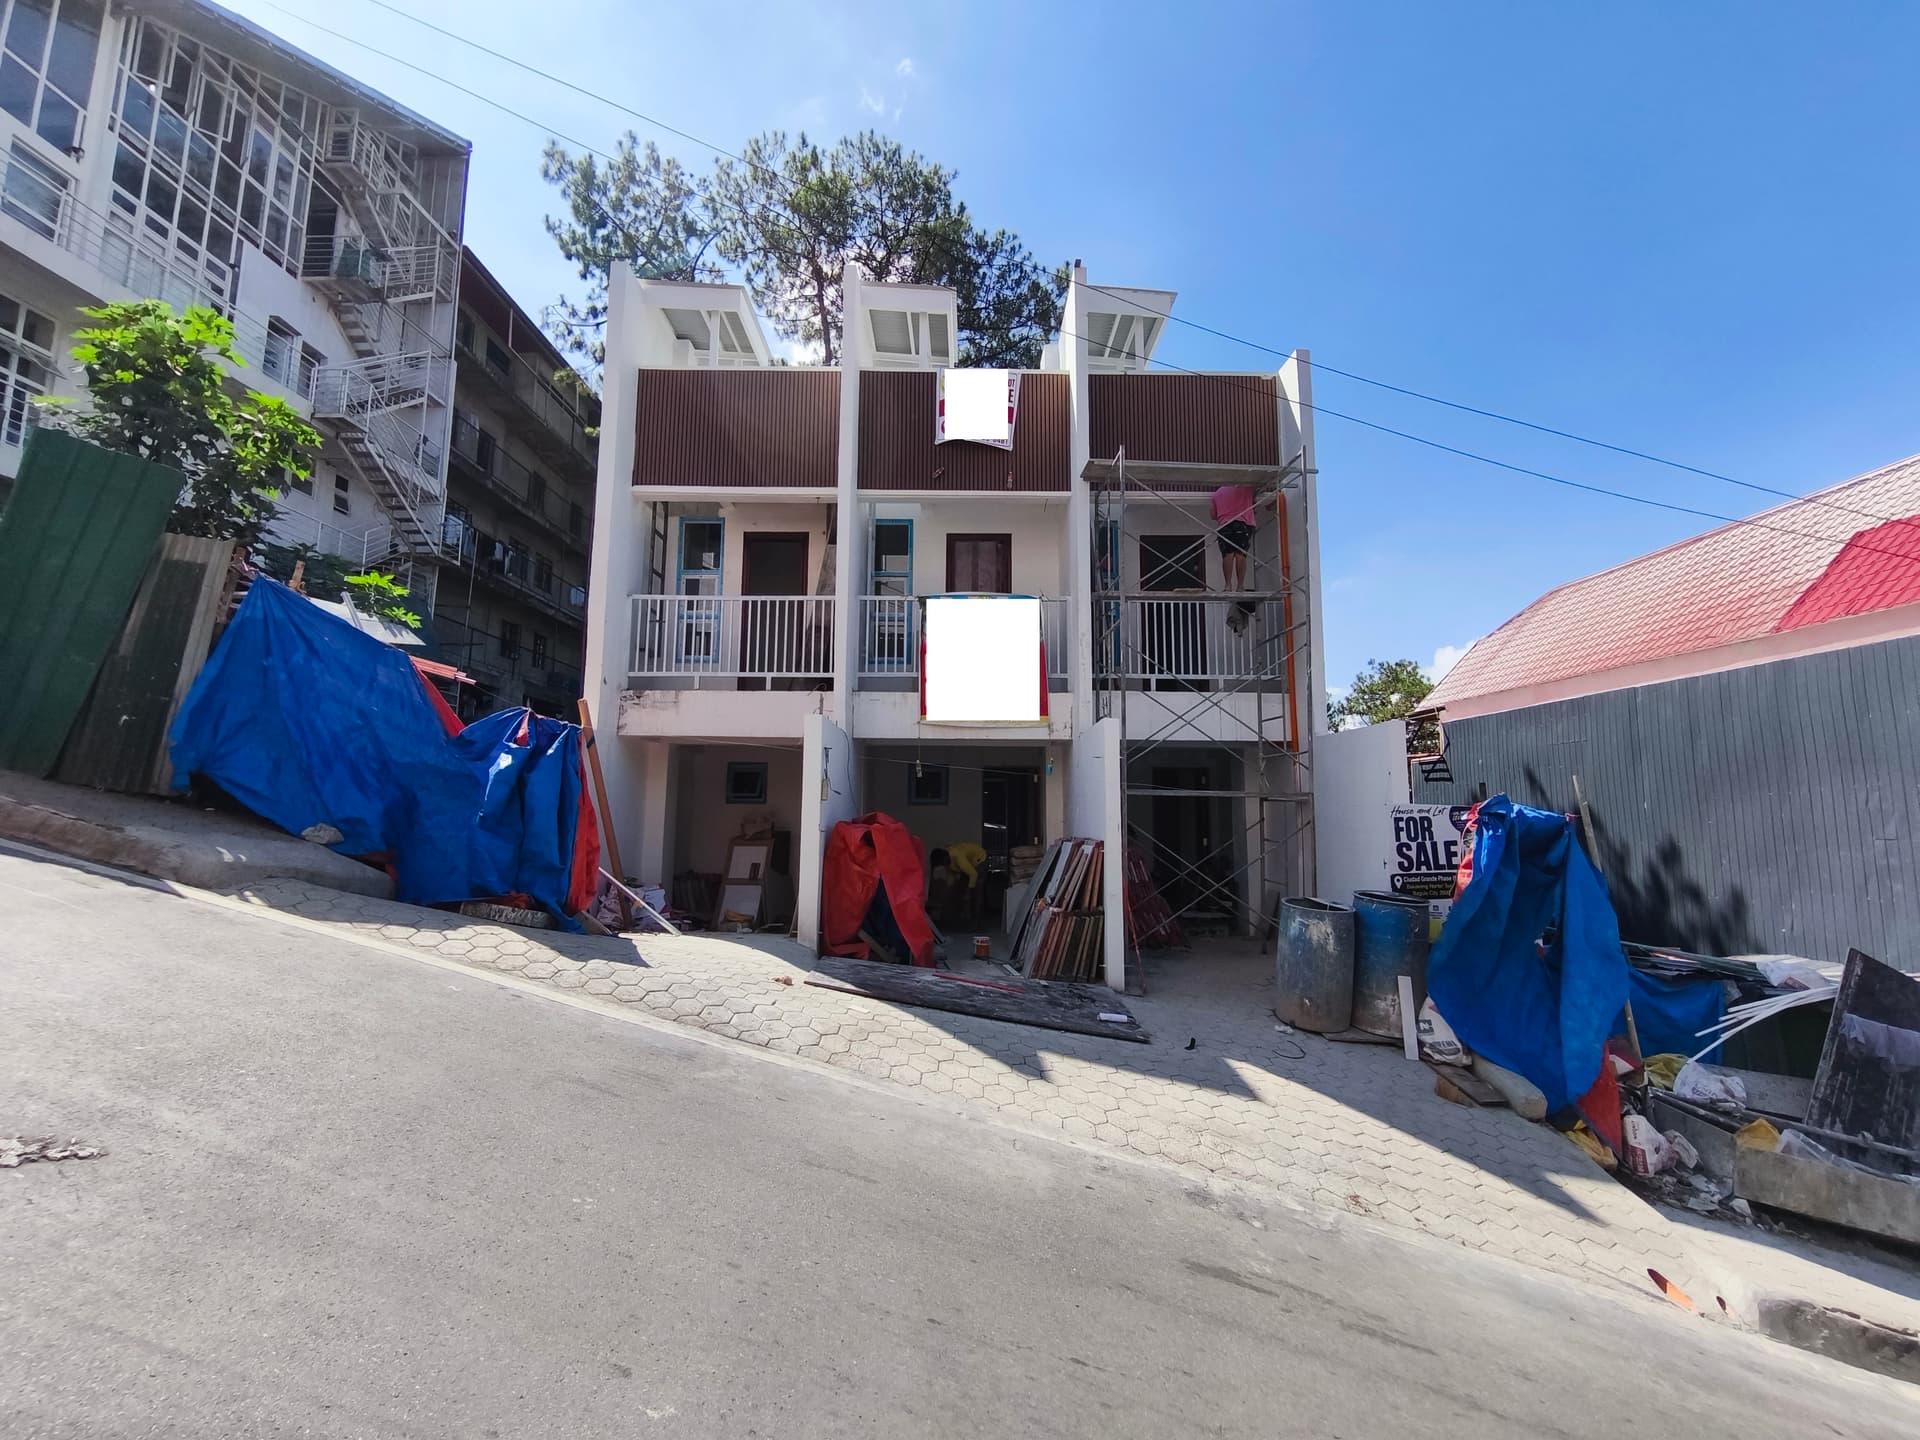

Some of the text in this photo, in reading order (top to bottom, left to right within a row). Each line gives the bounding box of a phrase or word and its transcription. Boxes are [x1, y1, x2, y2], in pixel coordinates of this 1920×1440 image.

[1391, 806, 1414, 818] House
[1417, 807, 1431, 815] and
[1432, 806, 1448, 817] Lot
[1394, 816, 1434, 842] FOR
[1396, 840, 1458, 872] SALE
